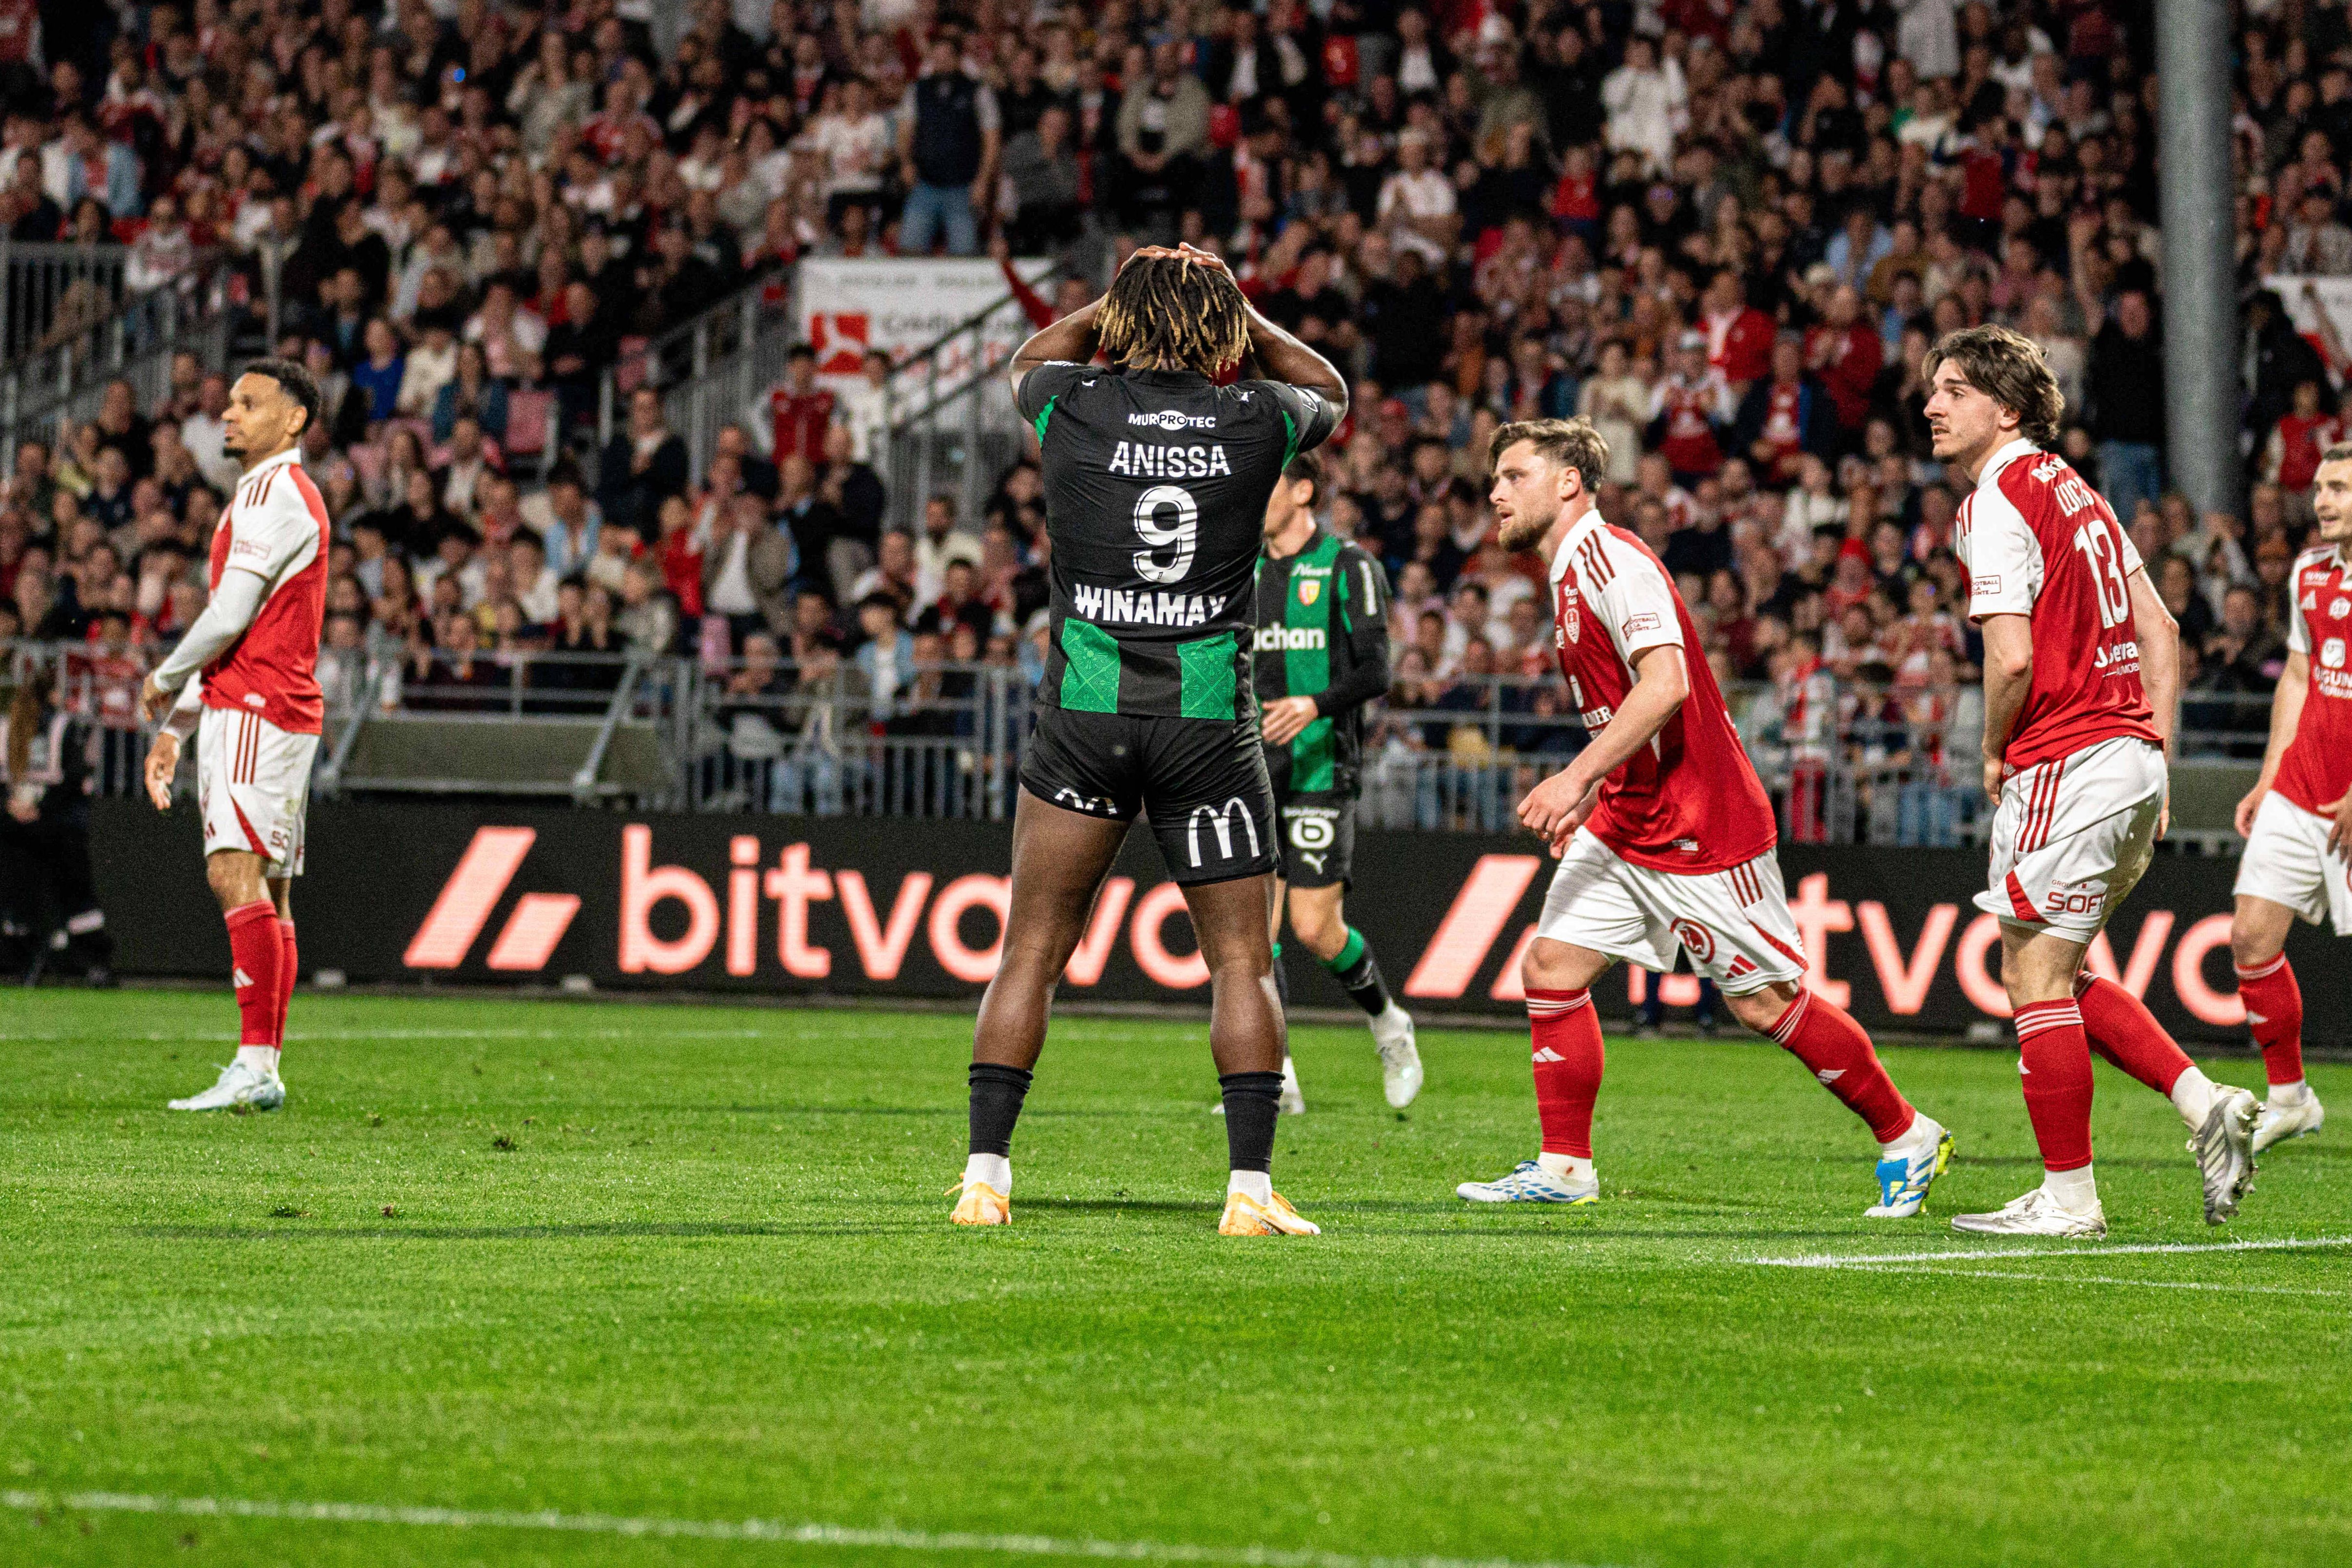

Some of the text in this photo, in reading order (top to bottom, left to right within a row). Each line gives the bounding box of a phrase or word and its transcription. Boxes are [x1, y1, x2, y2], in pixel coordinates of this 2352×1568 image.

[1128, 412, 1217, 429] MURPROTEC
[1108, 441, 1231, 477] ANISSA
[1133, 485, 1198, 584] 9
[2074, 520, 2129, 629] 13
[1254, 621, 1326, 651] chan
